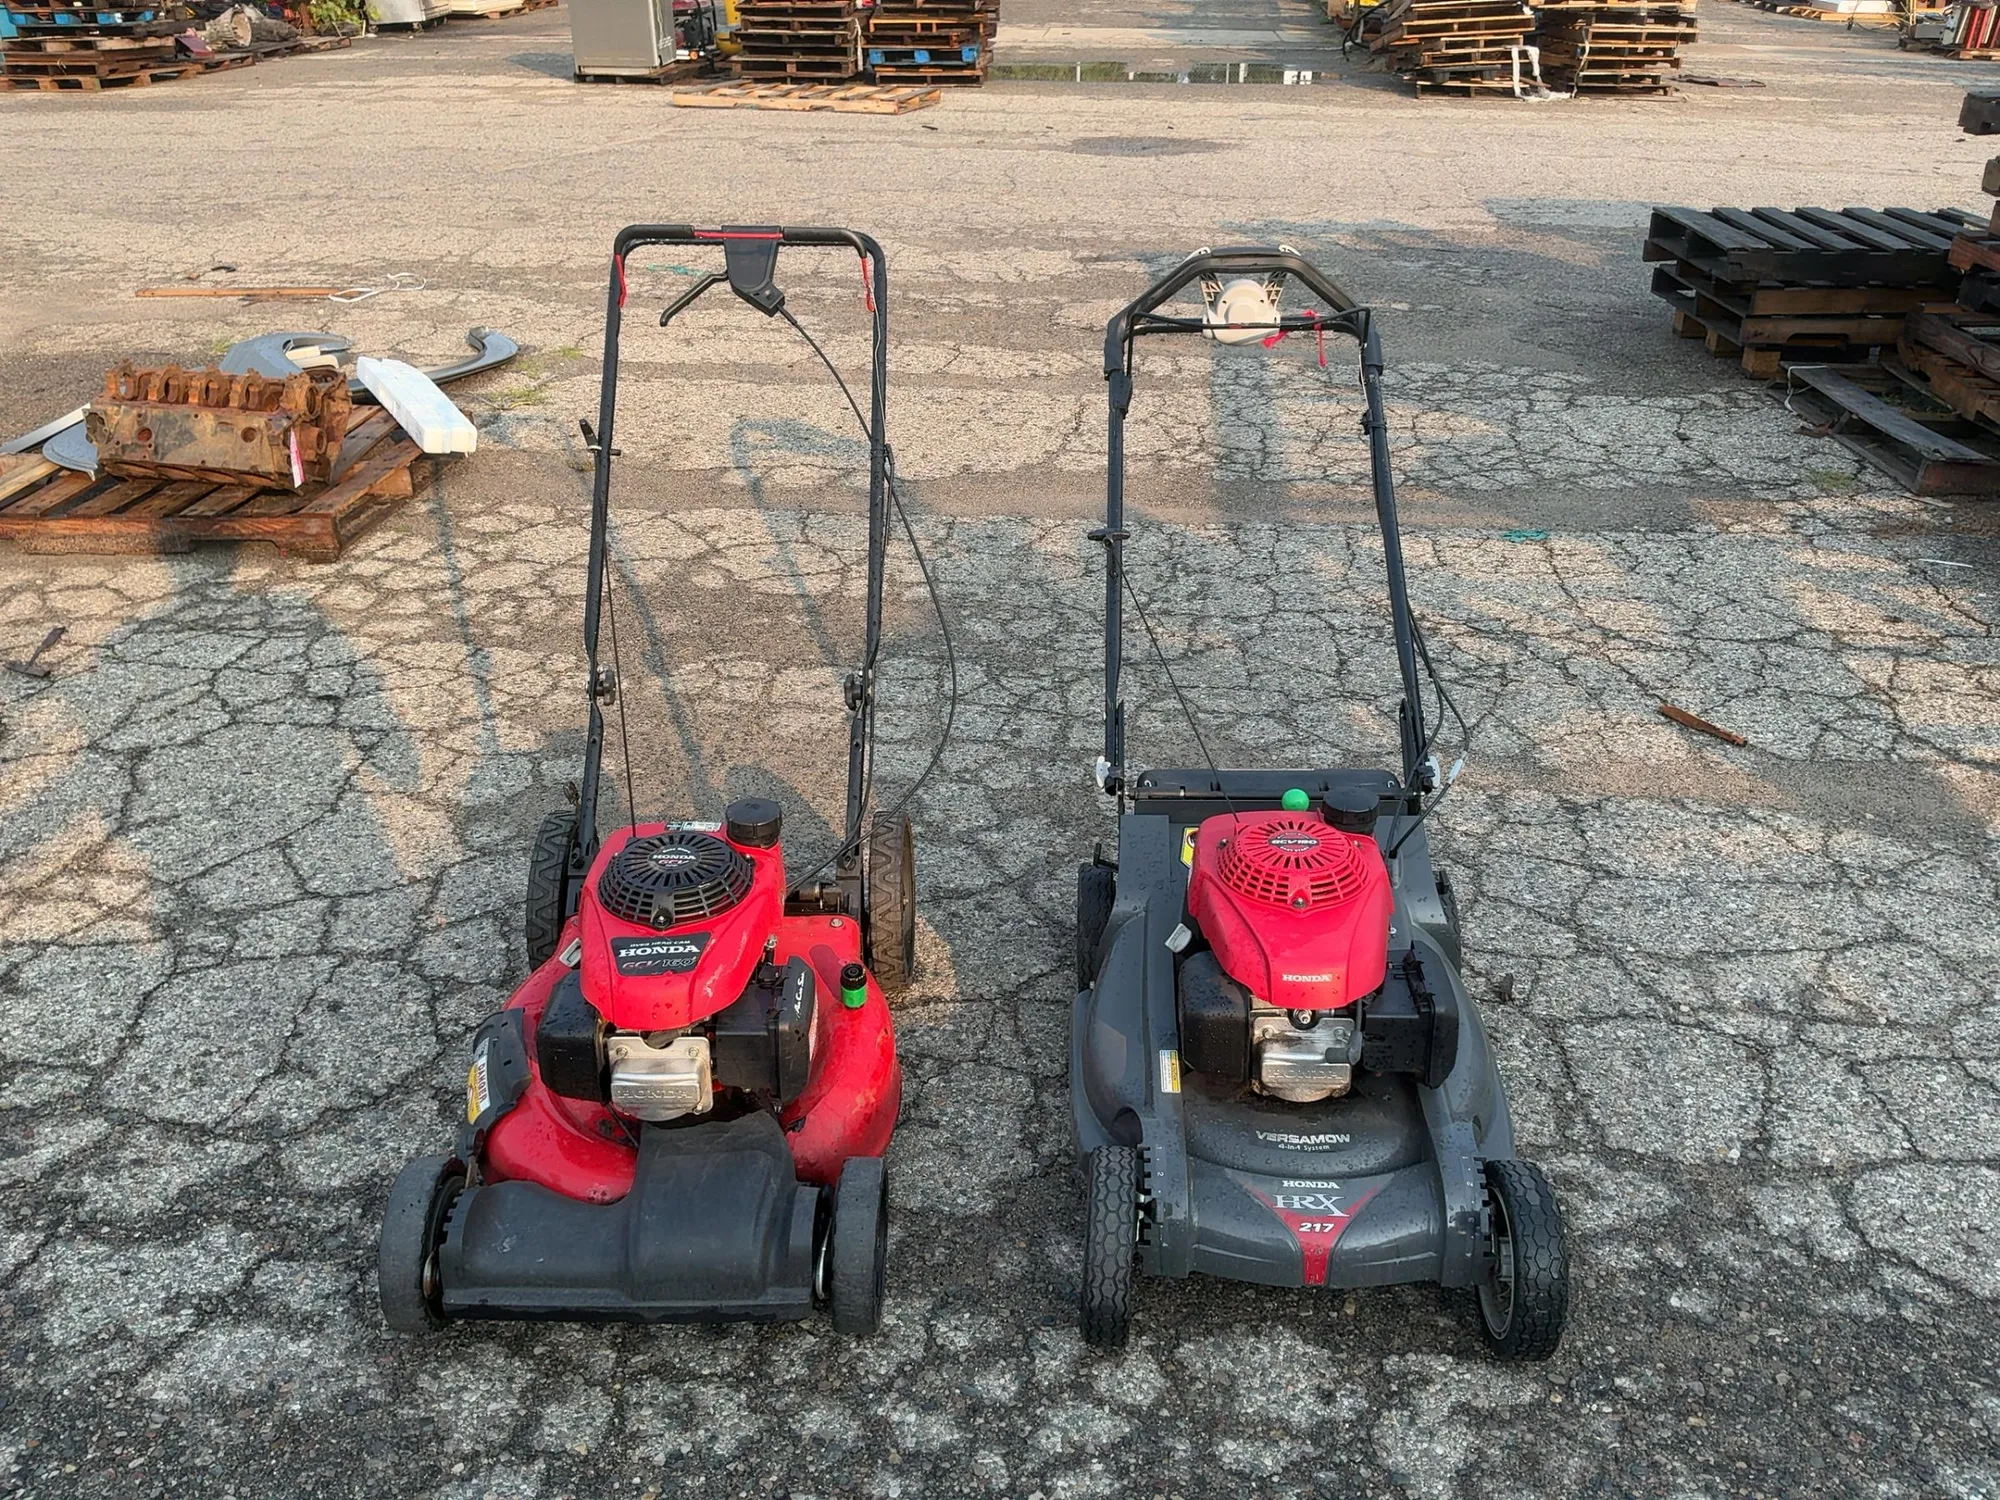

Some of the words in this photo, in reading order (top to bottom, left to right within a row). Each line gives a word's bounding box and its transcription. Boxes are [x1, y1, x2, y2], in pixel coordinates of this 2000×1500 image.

[618, 944, 700, 958] HONDA
[1282, 973, 1332, 983] HONDA
[1268, 1069, 1343, 1079] HONDA
[477, 1062, 488, 1104] DANGER
[617, 1090, 694, 1099] HONDA
[1255, 1130, 1351, 1145] VERSAMOW
[1303, 1143, 1330, 1152] System
[1282, 1180, 1340, 1189] HONDA
[1273, 1193, 1350, 1217] HRX
[1298, 1222, 1335, 1233] 217
